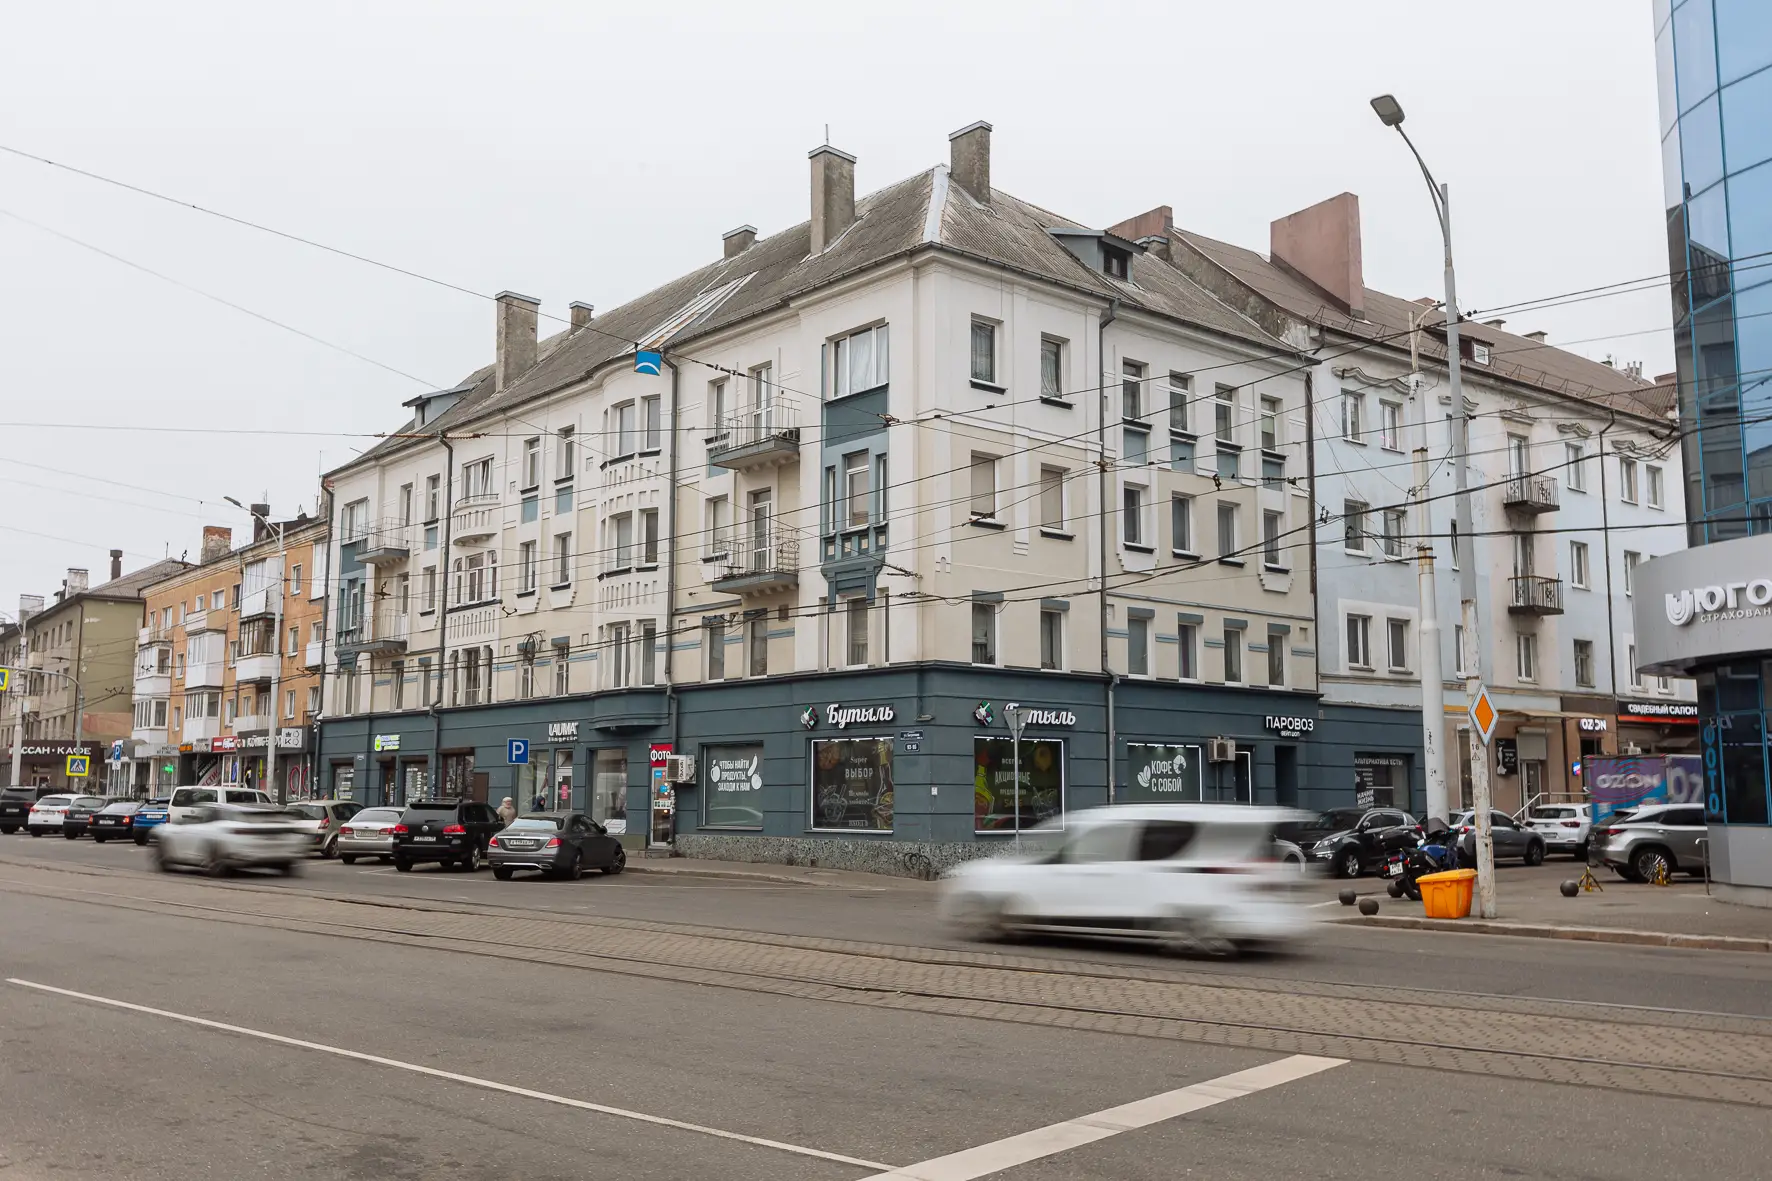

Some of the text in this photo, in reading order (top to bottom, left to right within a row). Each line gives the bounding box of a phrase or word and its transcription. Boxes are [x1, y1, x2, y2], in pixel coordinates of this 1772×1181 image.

[826, 703, 894, 729] Бутыль
[1005, 702, 1077, 726] тыль
[1628, 703, 1698, 715] СВАДЕБНЫЙ САЛОН
[1265, 715, 1314, 731] ПАРОВОЗ
[1581, 718, 1607, 731] OZON
[1471, 743, 1480, 751] 16
[844, 767, 874, 778] ВЫБОР
[1151, 760, 1173, 774] КОФЕ
[1703, 725, 1720, 815] ФОТО
[994, 770, 1031, 786] АКЦИОНЫЕ
[1151, 776, 1183, 792] С СОБОЙ
[1595, 773, 1661, 790] OZON
[1004, 799, 1024, 808] SAE
